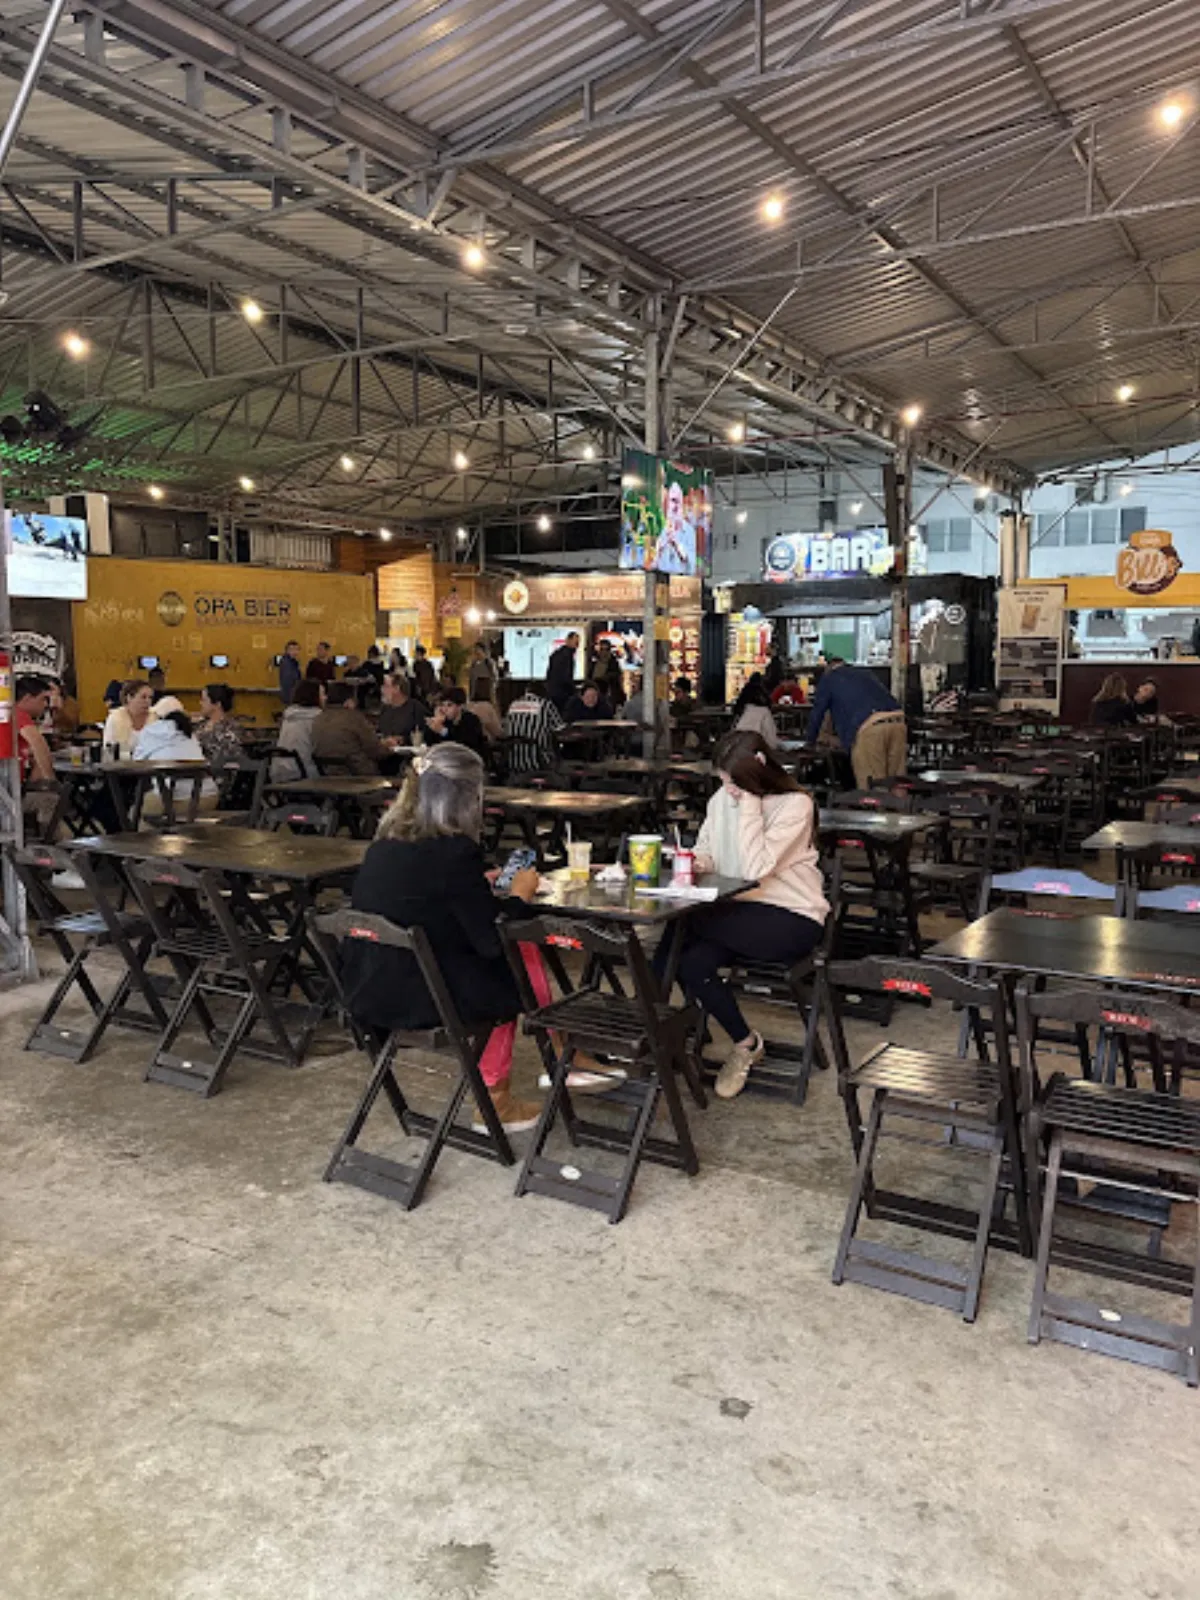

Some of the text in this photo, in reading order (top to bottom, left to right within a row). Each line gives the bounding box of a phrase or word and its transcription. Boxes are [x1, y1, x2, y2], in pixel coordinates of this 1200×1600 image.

[811, 538, 872, 571] BAR
[194, 597, 237, 616] OPA
[244, 599, 291, 616] BIER
